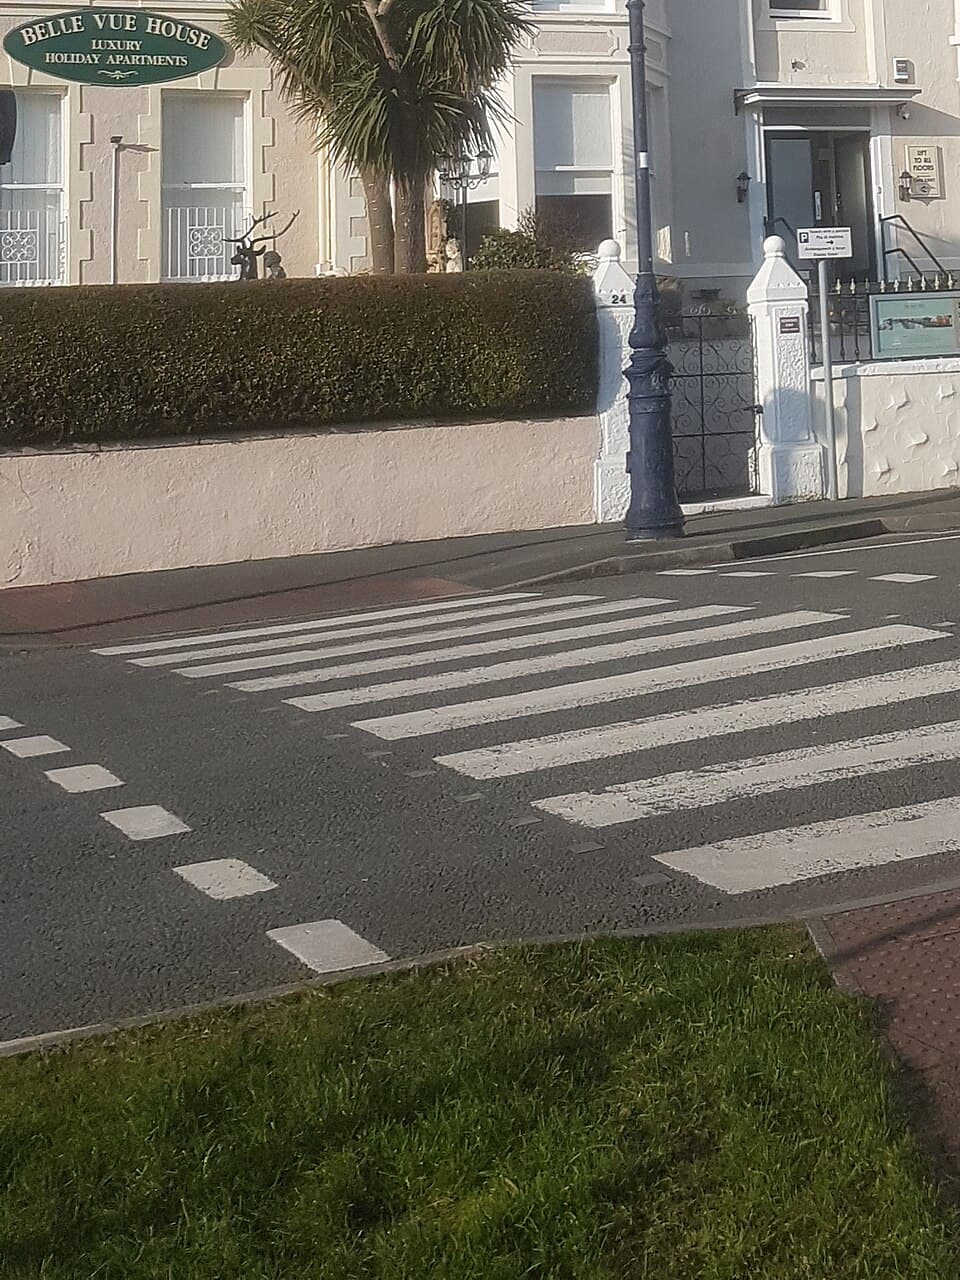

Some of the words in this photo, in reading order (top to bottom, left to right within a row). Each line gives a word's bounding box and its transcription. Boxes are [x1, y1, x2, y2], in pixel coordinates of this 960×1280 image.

[19, 15, 85, 46] BELLE
[93, 14, 137, 31] VUE
[145, 17, 211, 50] HOUSE
[91, 39, 143, 51] LUXURY
[45, 52, 101, 64] HOLIDAY
[106, 55, 188, 66] APARTMENTS
[611, 294, 627, 304] 24
